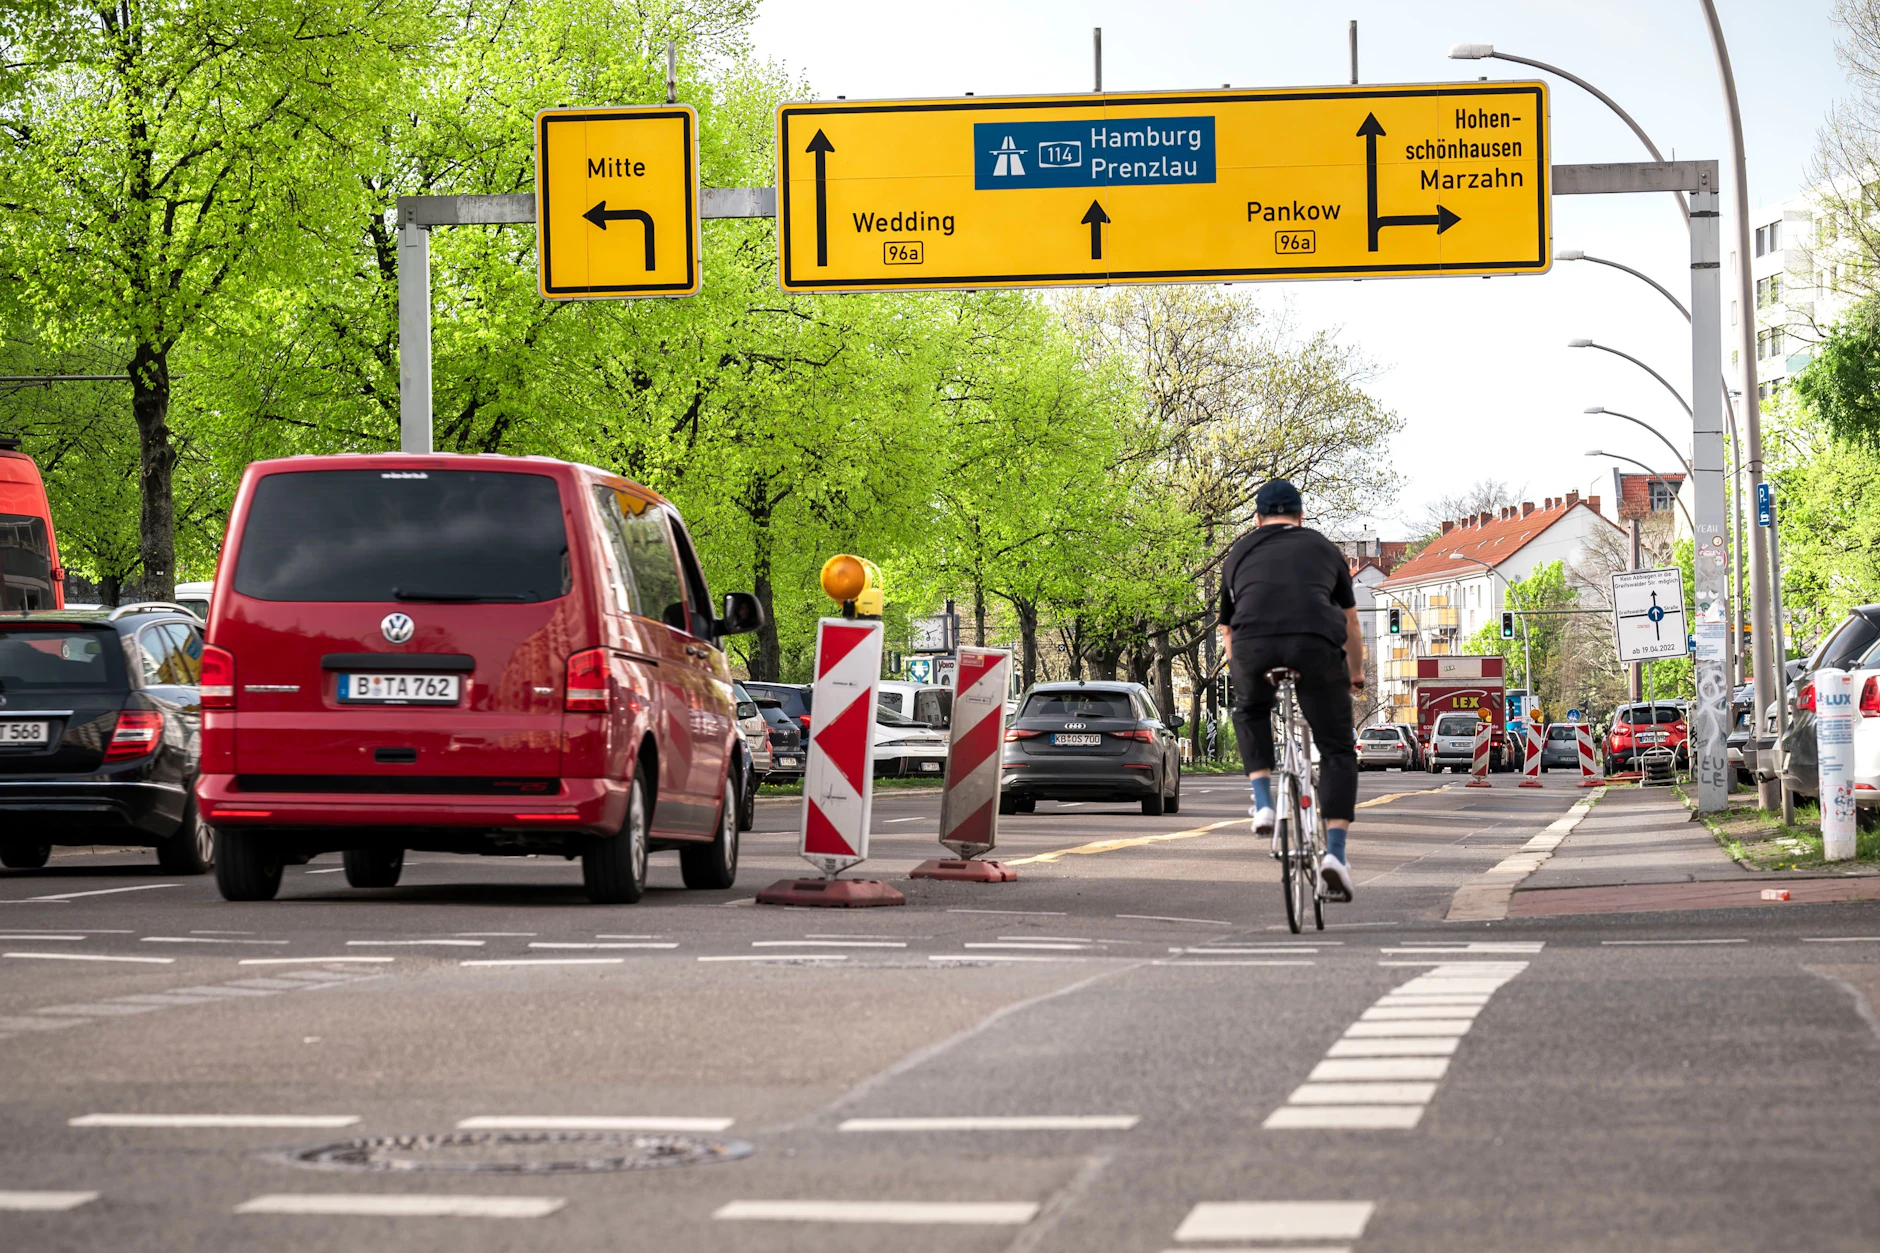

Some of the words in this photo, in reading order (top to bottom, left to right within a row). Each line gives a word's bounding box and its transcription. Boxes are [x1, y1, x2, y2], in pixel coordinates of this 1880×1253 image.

[1456, 108, 1521, 129] Hohen-
[1091, 126, 1201, 151] Hamburg
[1047, 147, 1073, 163] 114
[1405, 138, 1522, 160] schönhausen
[587, 158, 646, 179] Mitte
[1091, 156, 1198, 179] Prenzlau
[1421, 167, 1524, 190] Marzahn
[1247, 200, 1342, 222] Pankow
[852, 211, 955, 236] Wedding
[1280, 234, 1311, 250] 96a
[889, 245, 919, 262] 96a
[1695, 524, 1718, 533] YEAH
[1614, 581, 1647, 589] Greifswalder
[1658, 577, 1680, 585] möglich
[1618, 608, 1647, 616] Greifswalder
[1632, 647, 1641, 655] ab
[1642, 644, 1676, 653] 19.04.2022
[383, 677, 409, 696] TA
[412, 677, 450, 696] 762
[1452, 697, 1480, 708] LEX
[1825, 693, 1851, 706] LUX
[10, 724, 41, 740] 568
[1055, 735, 1067, 743] KB
[1084, 735, 1100, 743] 700
